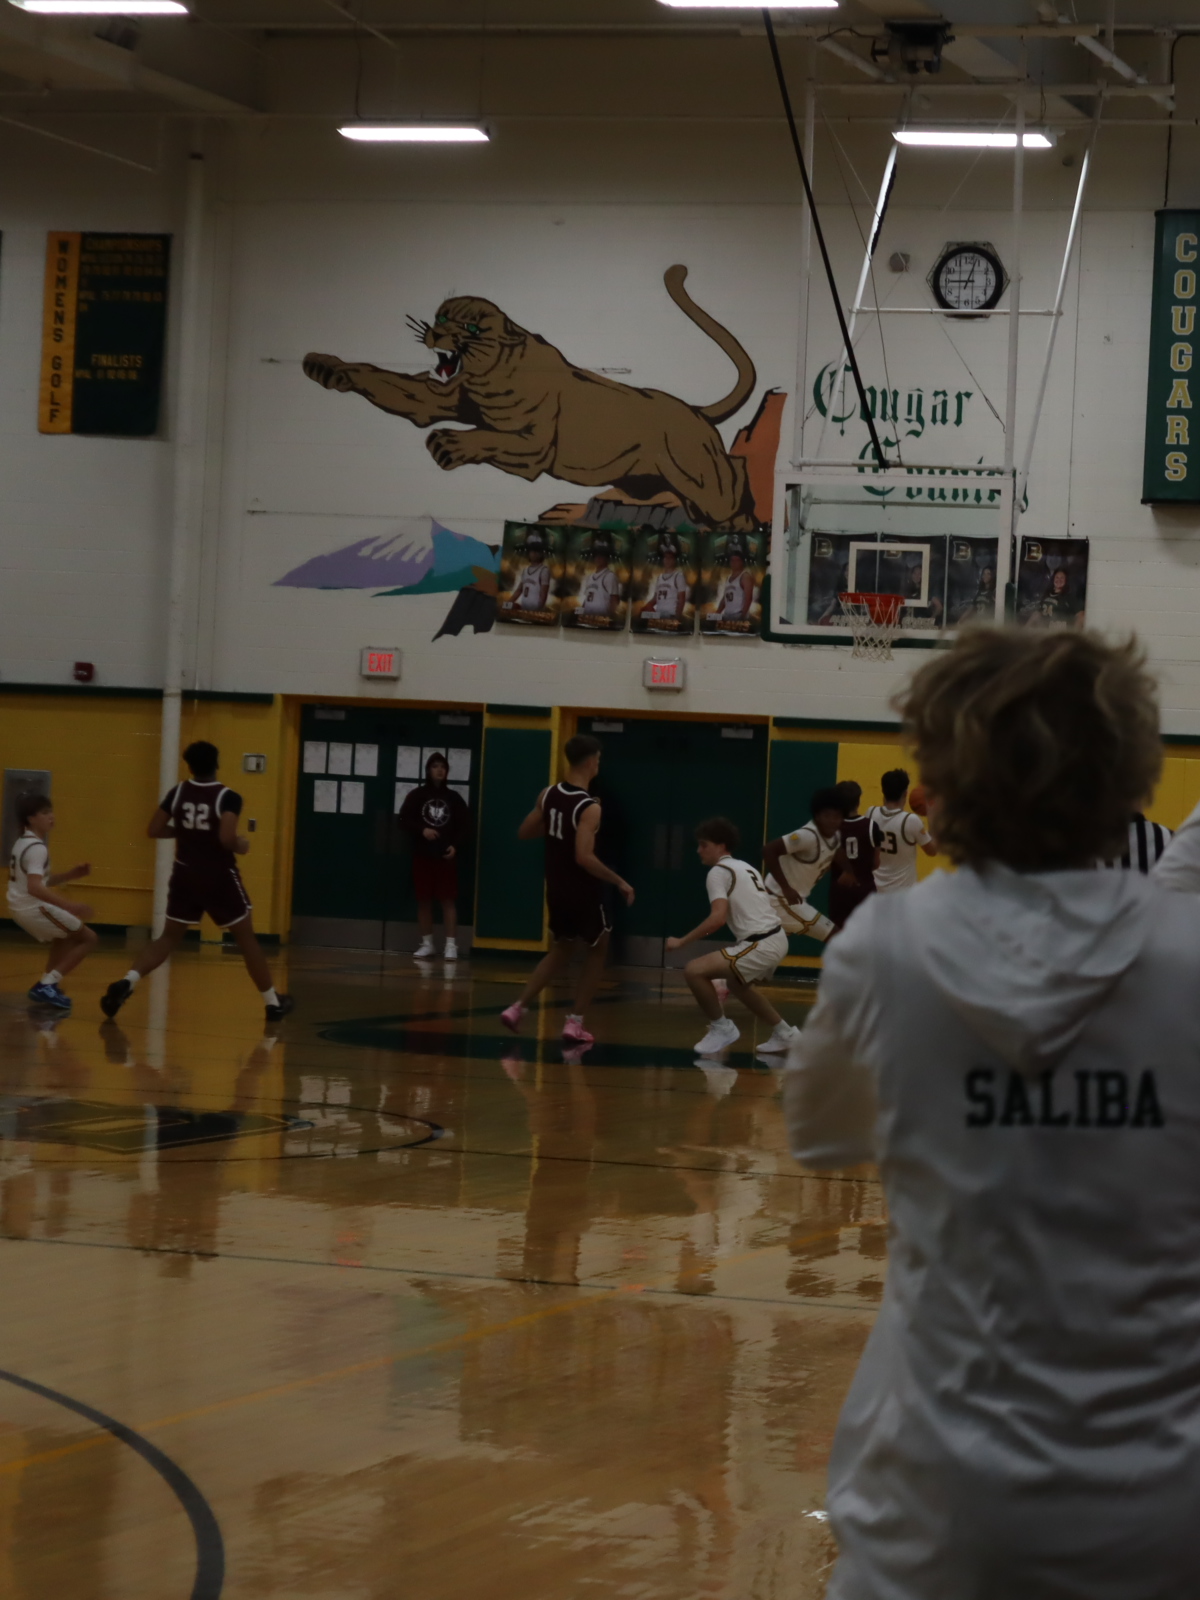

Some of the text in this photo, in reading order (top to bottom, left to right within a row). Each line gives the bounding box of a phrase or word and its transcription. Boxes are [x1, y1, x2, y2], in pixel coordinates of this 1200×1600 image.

[52, 240, 69, 343] WOMENS
[91, 354, 143, 368] FINALISTS
[1164, 232, 1198, 482] COUGARS
[49, 355, 62, 424] GOLF
[368, 653, 394, 672] EXIT
[651, 663, 677, 684] EXIT
[182, 802, 210, 830] 32
[549, 807, 564, 839] 11
[846, 837, 858, 859] 0
[964, 1067, 1165, 1129] SALIBA
